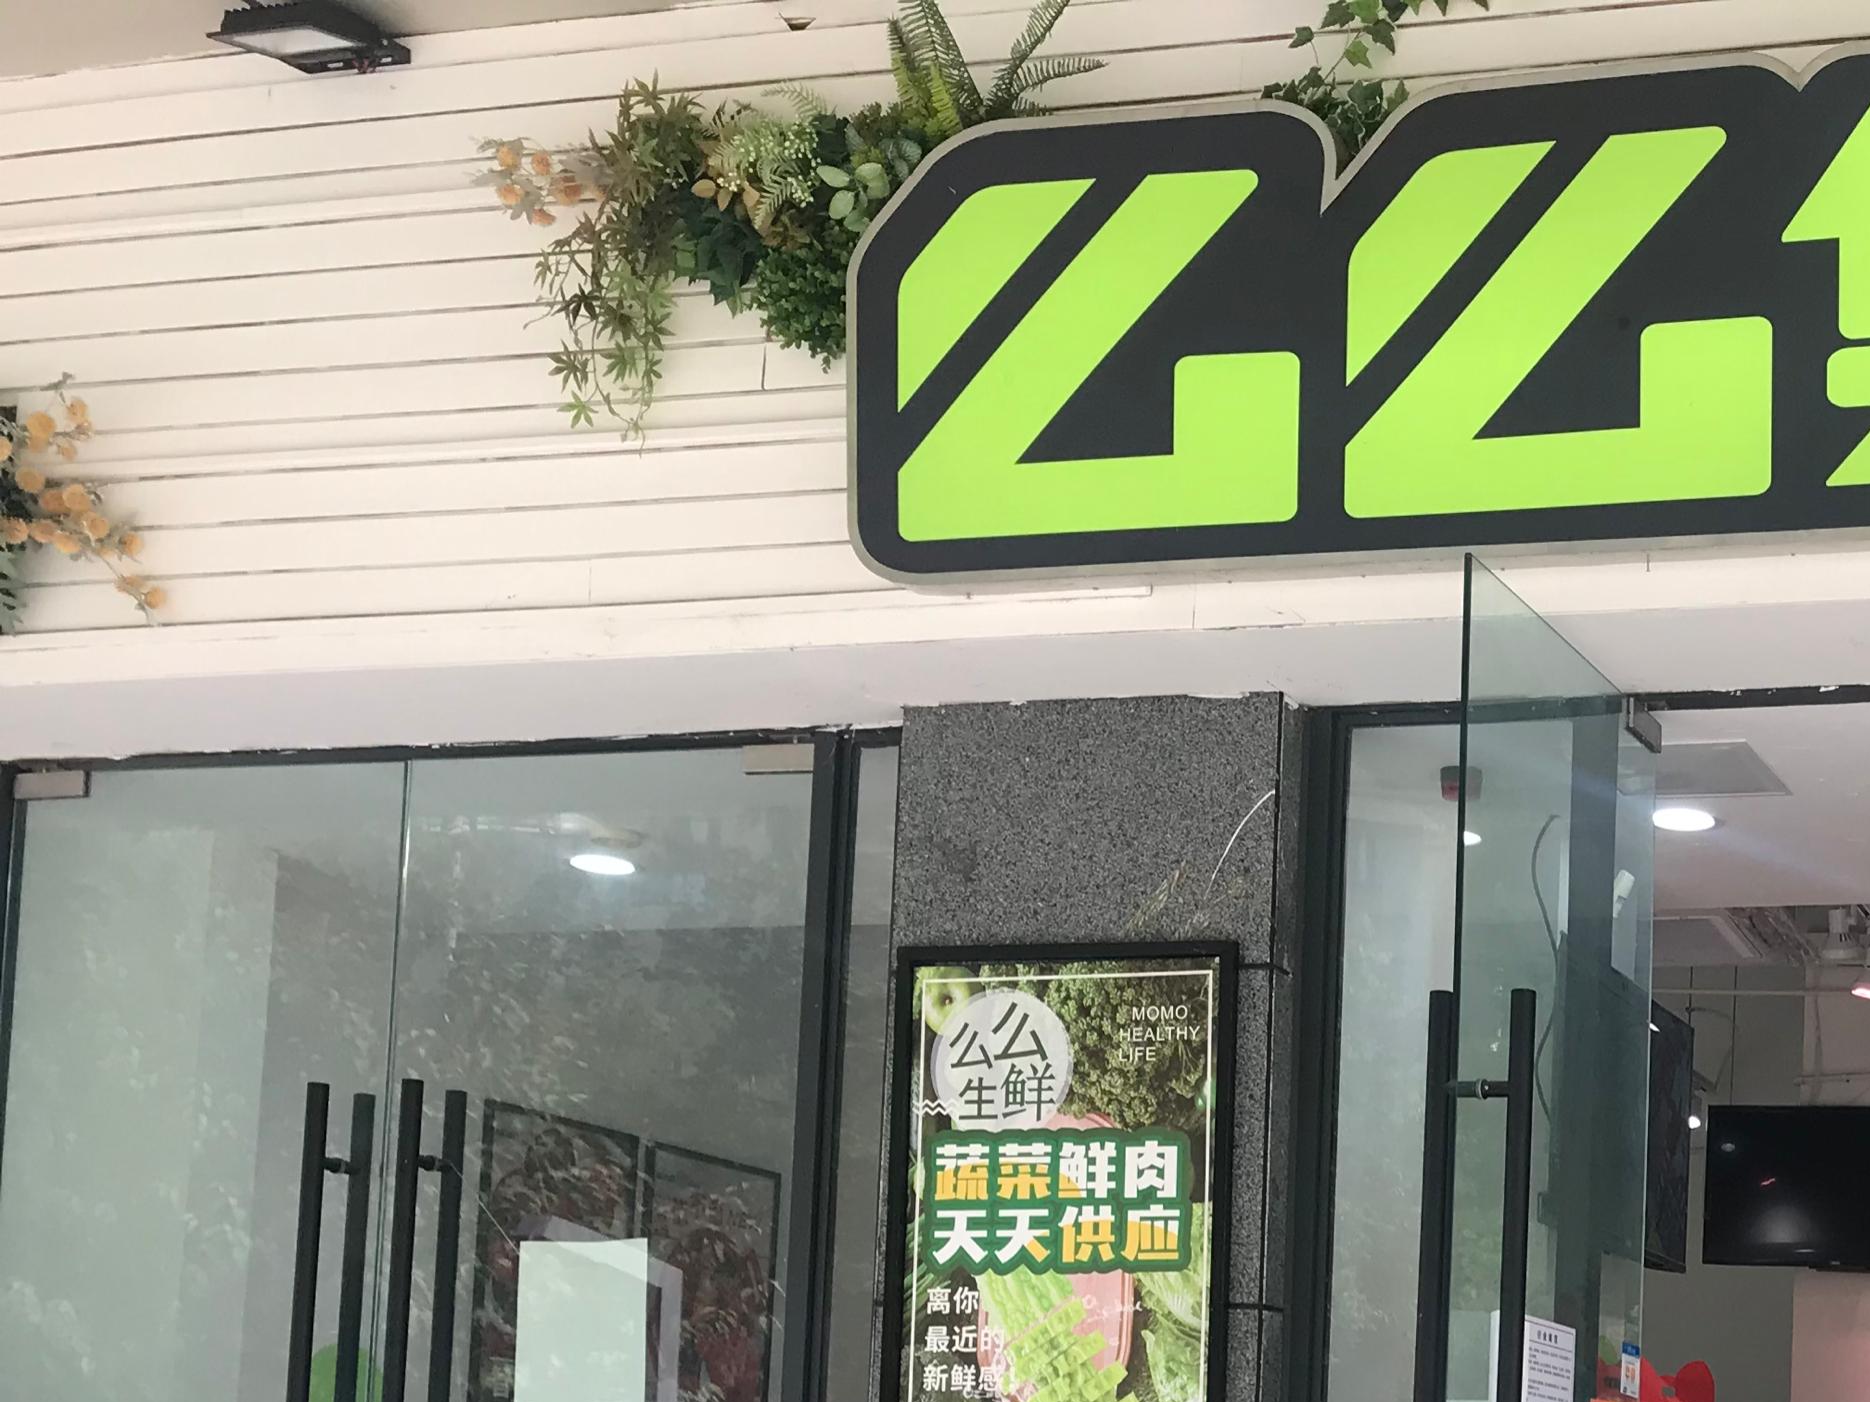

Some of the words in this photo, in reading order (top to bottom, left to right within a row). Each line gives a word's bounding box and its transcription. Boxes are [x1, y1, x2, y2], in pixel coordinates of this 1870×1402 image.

[1131, 1005, 1189, 1021] MOMO
[950, 1002, 1049, 1070] 么么
[1118, 1026, 1201, 1043] HEALTHY
[1118, 1047, 1158, 1063] LIFE
[956, 1062, 1057, 1123] 生鲜
[933, 1140, 1179, 1199] 蔬菜鲜肉
[932, 1205, 1181, 1264] 天天供应
[927, 1286, 979, 1314] 离你
[924, 1325, 1005, 1353] 最近的
